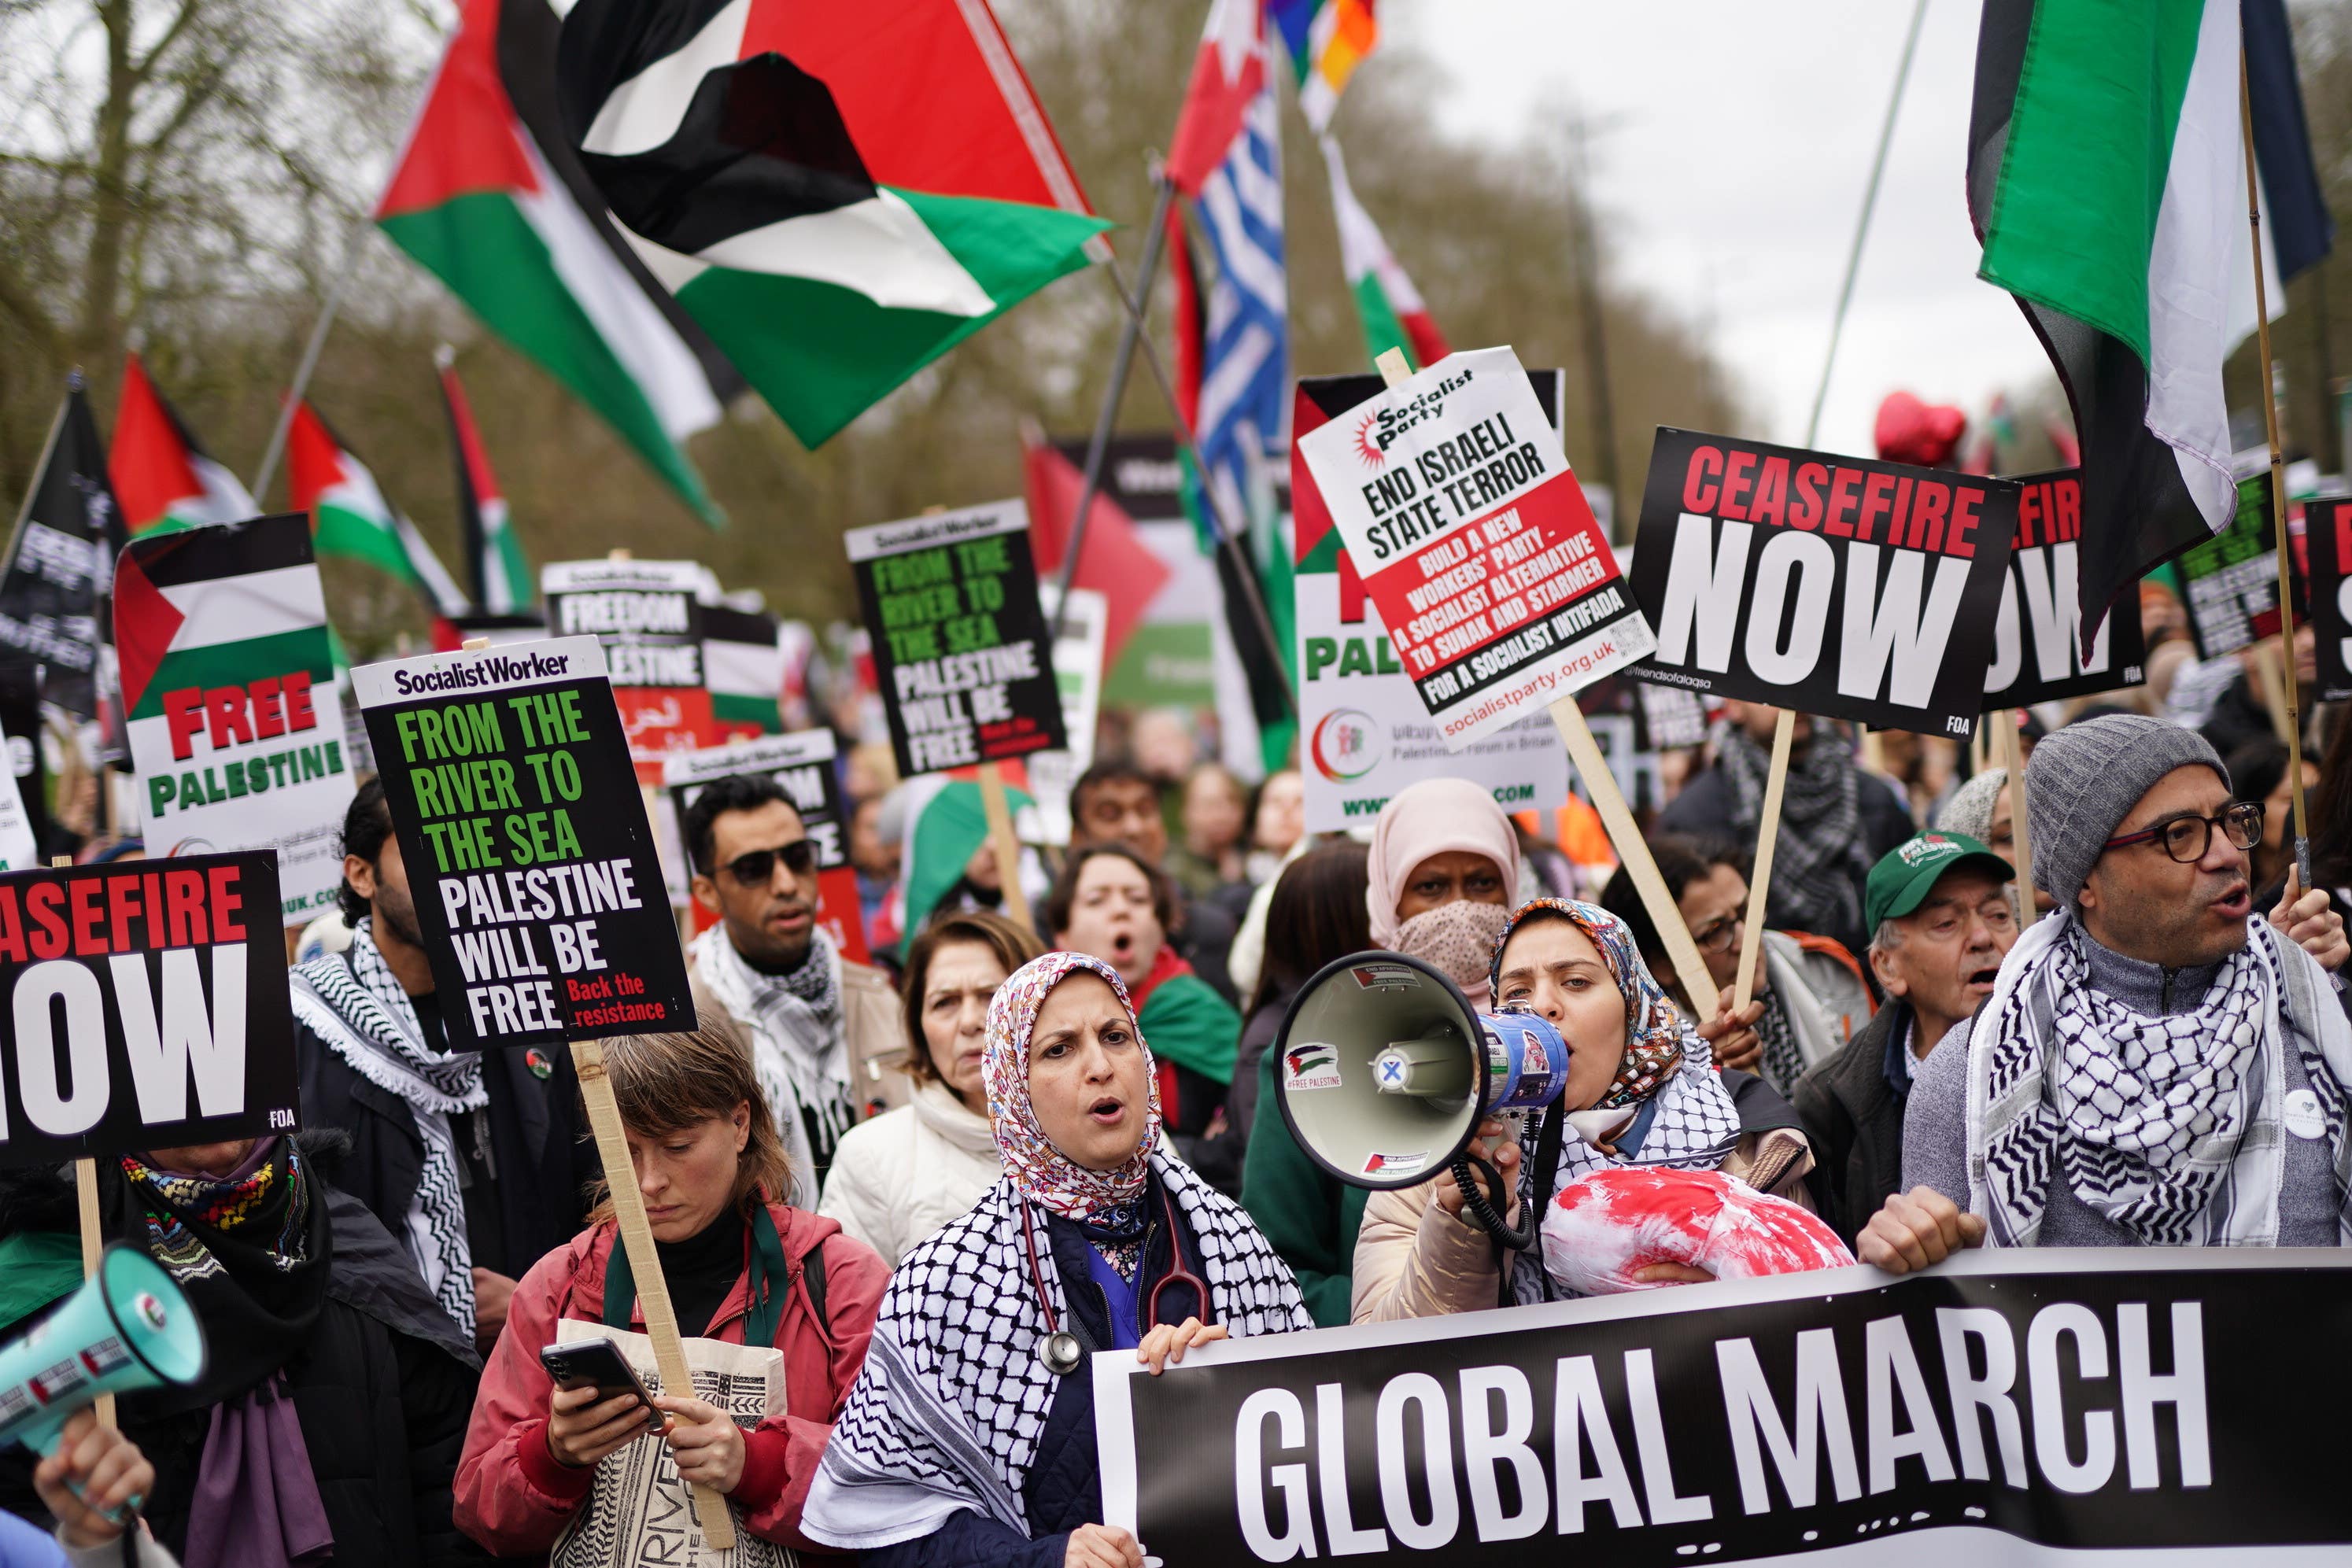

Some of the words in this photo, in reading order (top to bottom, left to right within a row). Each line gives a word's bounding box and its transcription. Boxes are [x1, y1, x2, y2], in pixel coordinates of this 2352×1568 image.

[1376, 369, 1474, 430] Socialist
[1376, 401, 1444, 452] Party
[1362, 465, 1416, 518] END
[1416, 411, 1516, 489] ISRAELI
[1367, 495, 1448, 559] STATE
[1443, 441, 1546, 518] TERROR
[1682, 445, 1985, 559] CEASEFIRE
[871, 548, 953, 596] FROM
[956, 535, 1013, 576] THE
[1418, 540, 1468, 578] BUILD
[1468, 529, 1484, 552] A
[1481, 507, 1523, 545] NEW
[1493, 525, 1546, 570] PARTY
[559, 592, 689, 633] FREEDOM
[879, 583, 961, 626] RIVER
[966, 576, 1004, 613] TO
[1393, 627, 1412, 652] A
[1412, 585, 1491, 644] SOCIALIST
[1494, 530, 1596, 600] ALTERNATIVE
[1411, 647, 1436, 672] TO
[1438, 621, 1494, 663] SUNAK
[1494, 600, 1528, 630] AND
[1530, 556, 1607, 615] STARMER
[1655, 512, 1972, 710] NOW
[607, 645, 702, 686] LESTINE
[887, 625, 941, 662] THE
[944, 614, 1002, 652] SEA
[1423, 675, 1459, 706] FOR
[1460, 666, 1477, 689] A
[1477, 622, 1553, 679] SOCIALIST
[1551, 586, 1626, 641] INTIFADA
[893, 640, 1039, 699] PALESTINE
[1445, 640, 1616, 736] socialistparty.org.uk
[1624, 665, 1712, 689] @friendsofalaqsa
[2124, 666, 2143, 683] FOA
[162, 670, 317, 762] FREE
[395, 701, 506, 763] FROM
[508, 690, 591, 748] THE
[900, 693, 972, 736] WILL
[971, 684, 1014, 724] BE
[1946, 715, 1970, 735] FOA
[148, 740, 344, 818] PALESTINE
[908, 727, 980, 772] FREE
[409, 758, 522, 818] RIVER
[526, 750, 582, 804] TO
[423, 817, 502, 873] THE
[504, 809, 583, 866] SEA
[0, 866, 246, 963] ASEFIRE
[438, 858, 642, 928] PALESTINE
[450, 926, 548, 983] WILL
[549, 920, 607, 974] BE
[466, 981, 563, 1038] FREE
[567, 976, 616, 1002] Back
[615, 972, 644, 998] the
[574, 999, 666, 1028] resistance
[0, 943, 247, 1140] OW
[1288, 1079, 1307, 1089] #FREE
[1309, 1075, 1341, 1087] PALESTINE
[270, 1109, 295, 1128] FOA
[1235, 1348, 1714, 1563] GLOBAL
[1715, 1301, 2212, 1515] MARCH
